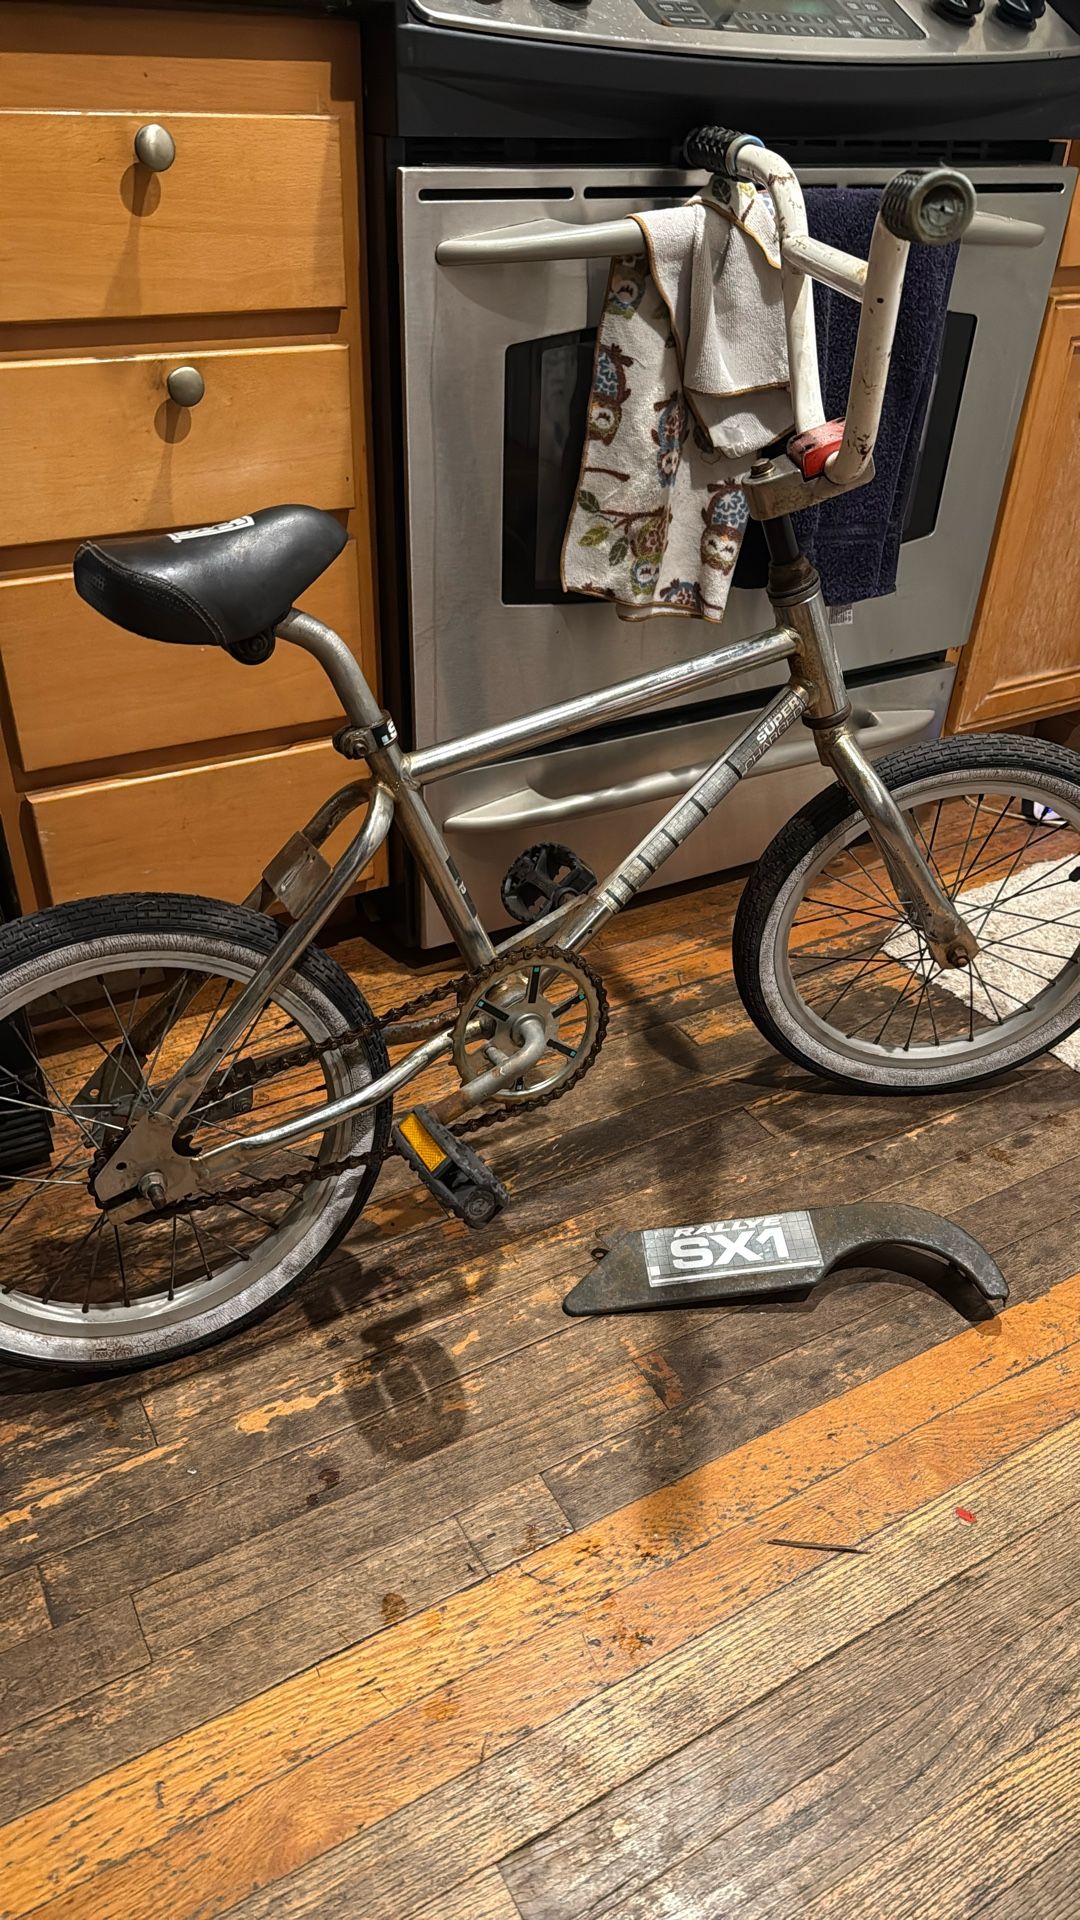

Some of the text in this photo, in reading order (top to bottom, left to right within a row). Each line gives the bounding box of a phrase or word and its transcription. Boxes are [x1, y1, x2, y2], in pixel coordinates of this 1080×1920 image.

[743, 706, 803, 774] CHARGED
[757, 697, 800, 744] SUPER
[670, 1227, 790, 1269] SX1
[673, 1216, 783, 1237] RALLYE
